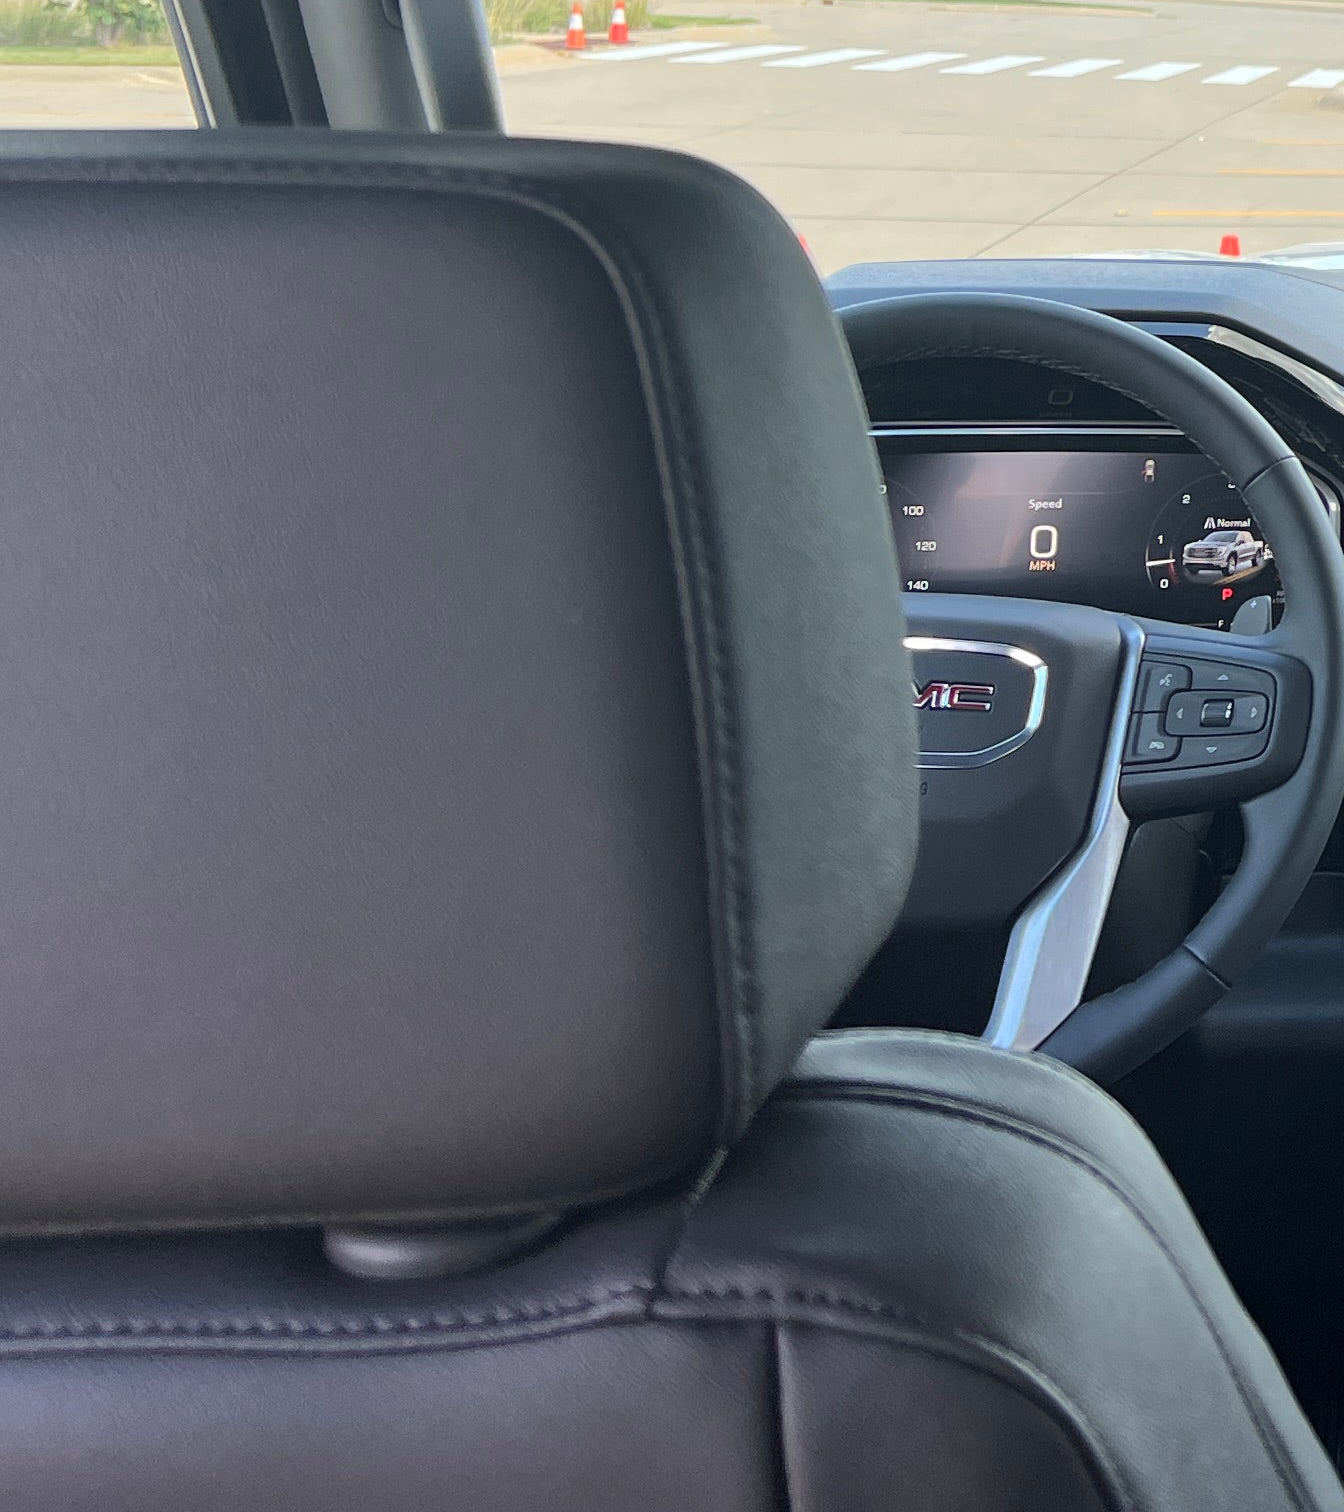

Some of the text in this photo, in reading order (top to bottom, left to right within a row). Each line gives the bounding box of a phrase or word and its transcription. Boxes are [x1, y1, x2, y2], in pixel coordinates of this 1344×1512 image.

[1028, 497, 1063, 511] Speed
[1182, 494, 1191, 505] 2
[902, 505, 925, 516] 100
[1217, 517, 1251, 528] Normal
[1030, 524, 1058, 558] 0
[1157, 534, 1164, 545] 1
[915, 541, 937, 551] 120
[1028, 560, 1056, 571] MPH
[907, 580, 929, 591] 140
[1159, 578, 1169, 589] 0
[1222, 587, 1234, 600] P
[912, 681, 994, 711] MC
